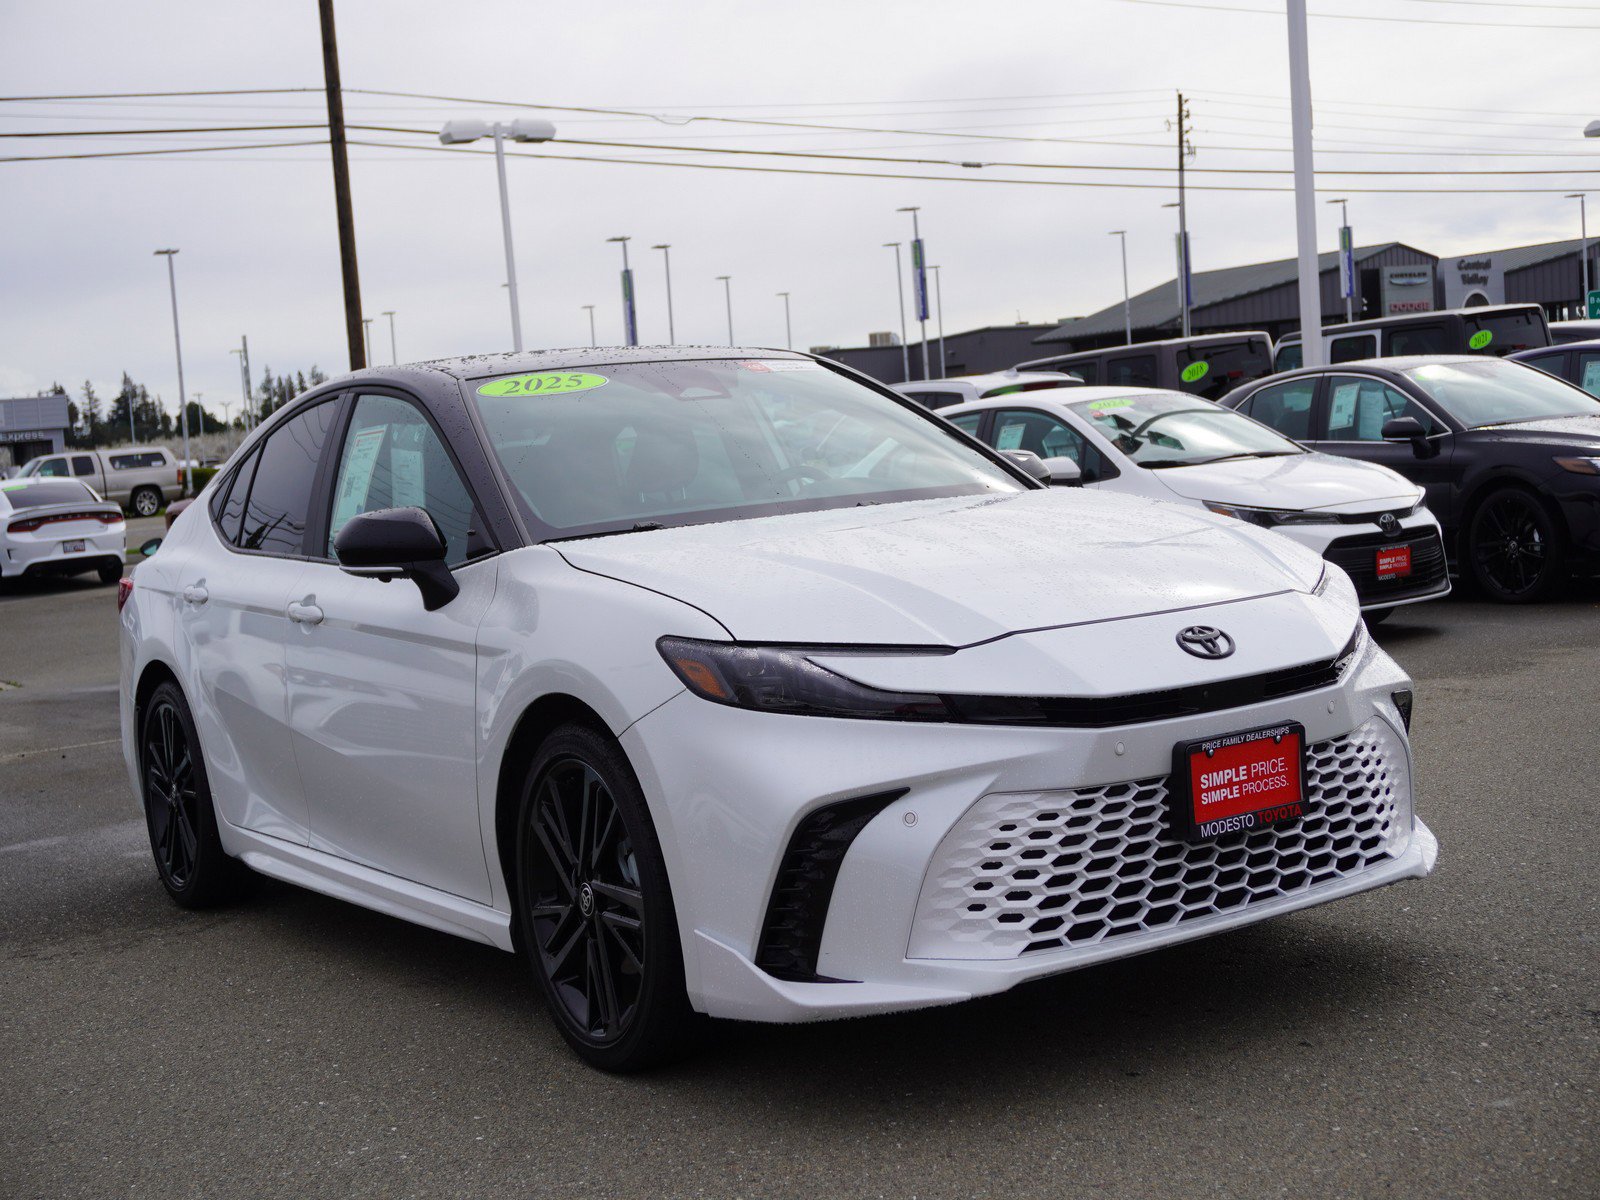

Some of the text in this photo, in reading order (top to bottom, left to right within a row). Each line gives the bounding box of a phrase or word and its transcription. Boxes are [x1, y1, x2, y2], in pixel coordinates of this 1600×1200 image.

[1474, 331, 1488, 347] 2021
[1187, 363, 1204, 380] 2018
[503, 375, 583, 395] 2025
[1202, 727, 1290, 751] PRICE FAMILY DEALERSHIPS
[1200, 757, 1288, 789] SIMPLE PRICE.
[1201, 775, 1289, 805] SIMPLE PROCESS.
[1201, 804, 1302, 838] MODESTO TOYOTA
